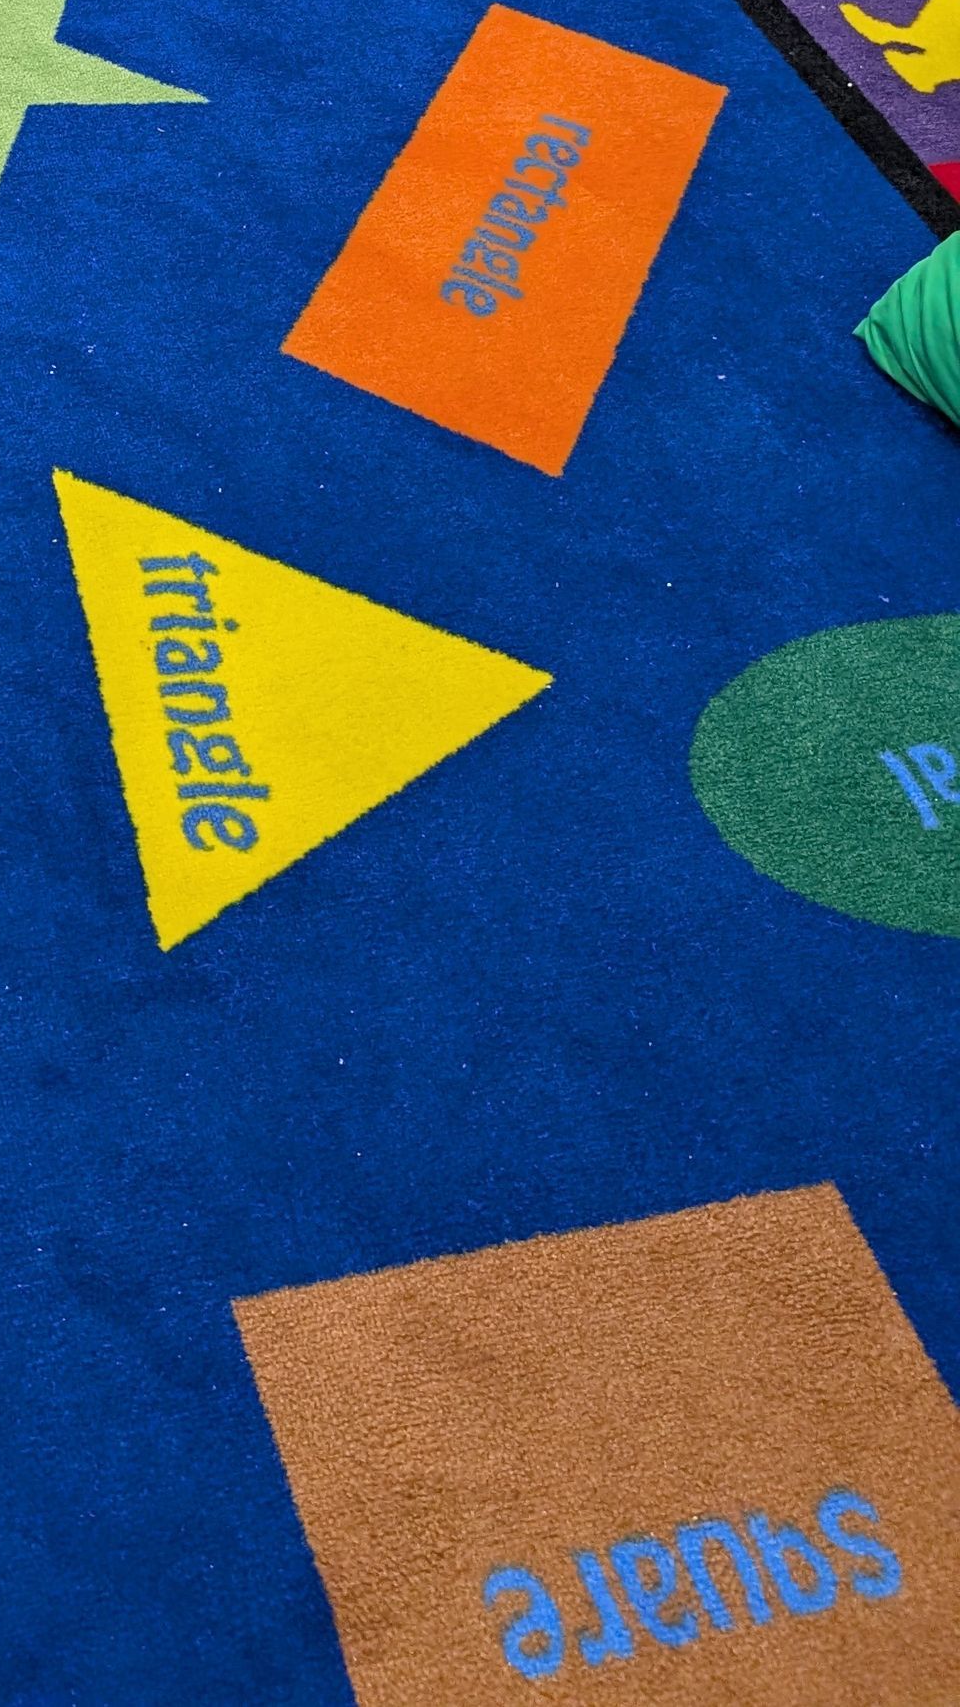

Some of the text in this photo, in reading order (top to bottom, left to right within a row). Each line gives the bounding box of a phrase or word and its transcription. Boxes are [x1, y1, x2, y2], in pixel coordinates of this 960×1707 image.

[441, 114, 593, 318] rectangle
[138, 552, 272, 854] triangle
[483, 1485, 903, 1681] square
